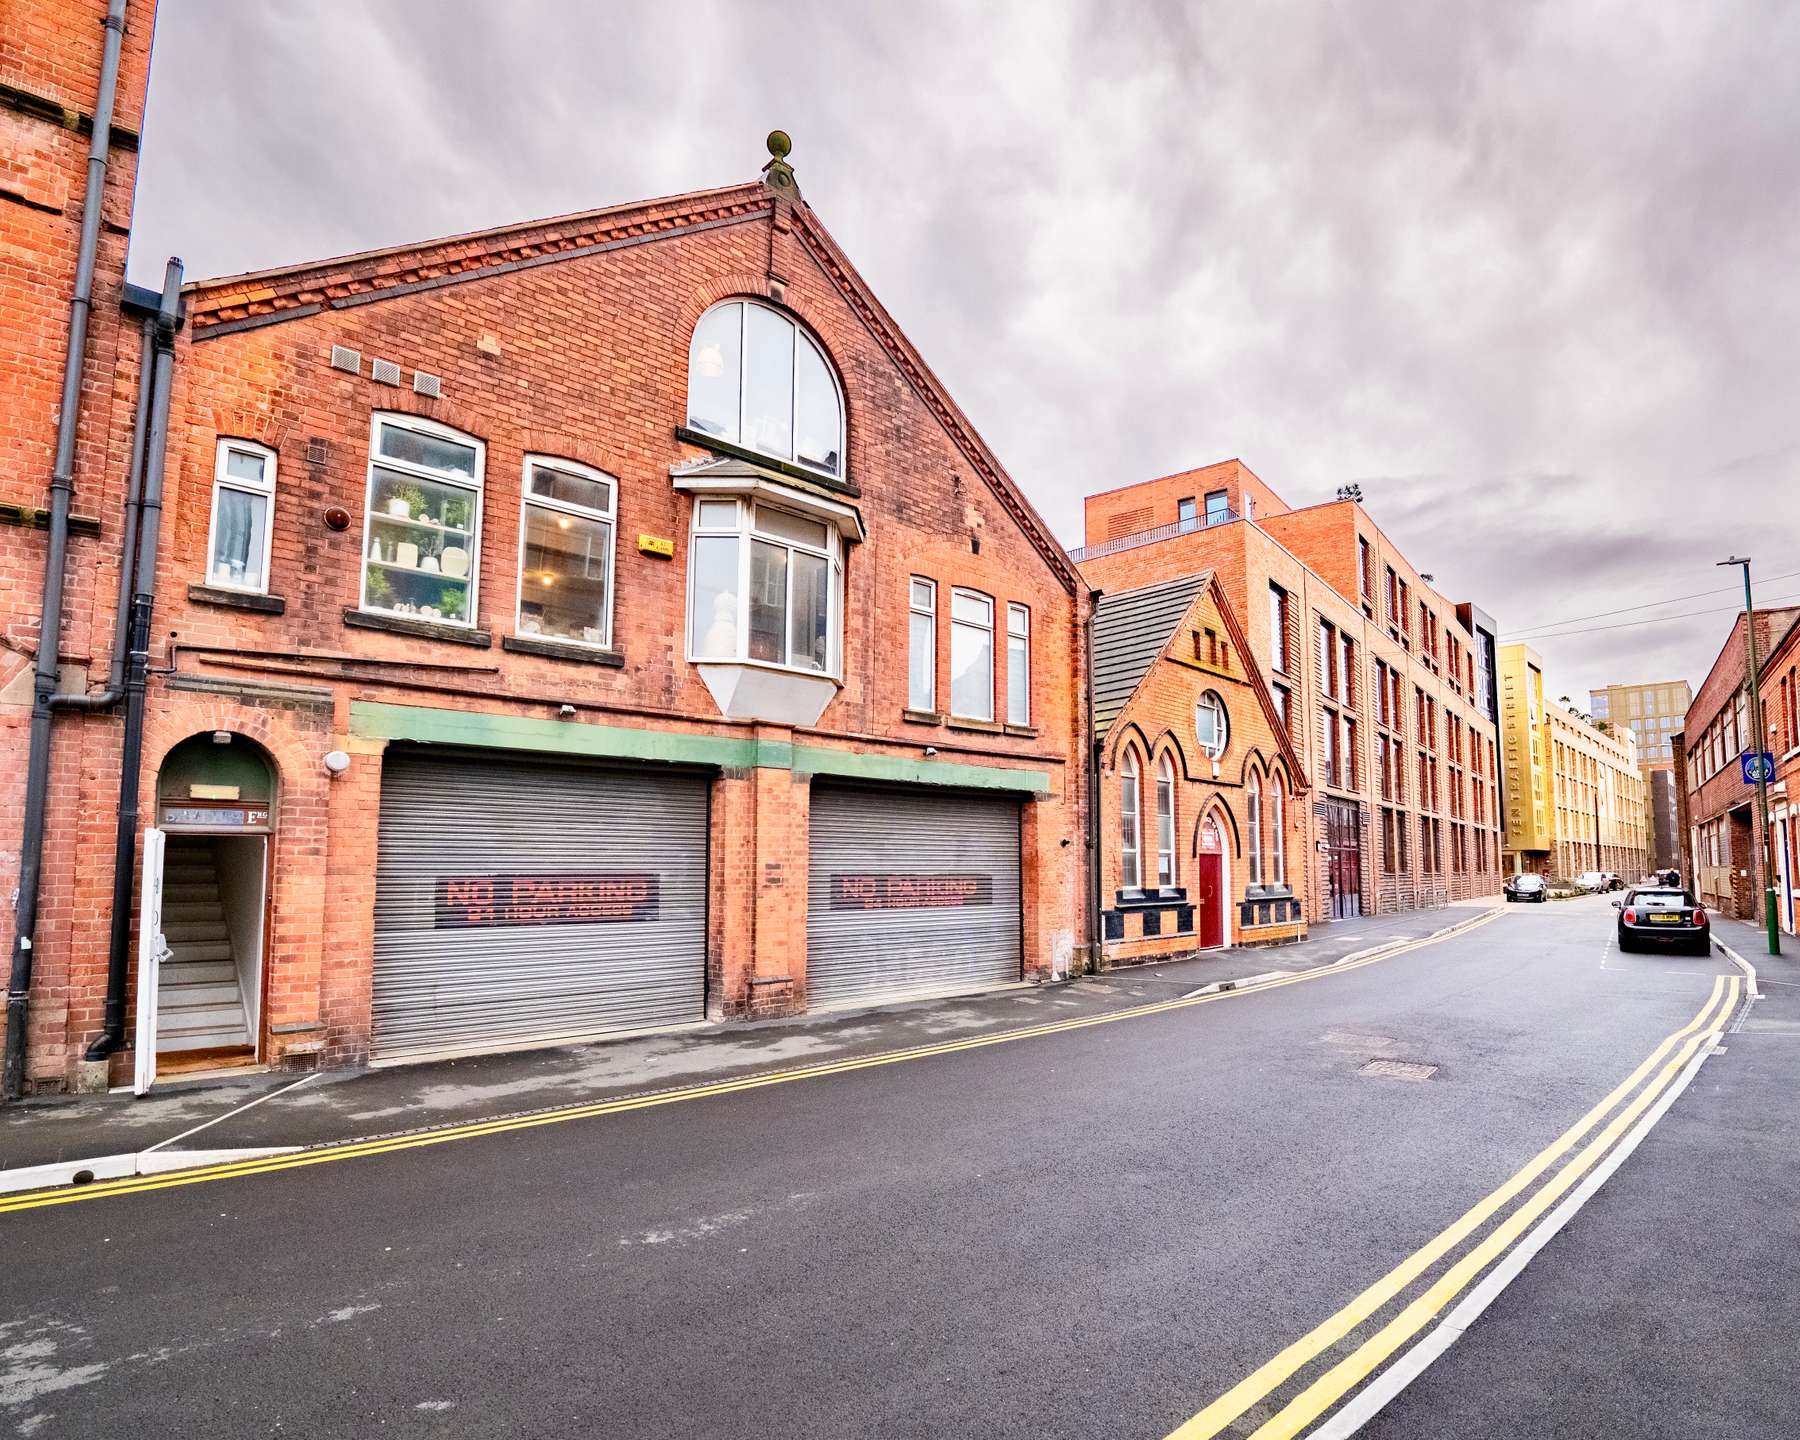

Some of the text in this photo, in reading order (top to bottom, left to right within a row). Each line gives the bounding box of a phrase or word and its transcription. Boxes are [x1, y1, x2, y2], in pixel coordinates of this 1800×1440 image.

[1504, 673, 1521, 837] TEN TRAFFIC STREET
[447, 879, 648, 906] NO PARKING
[842, 877, 977, 898] NO PARKING
